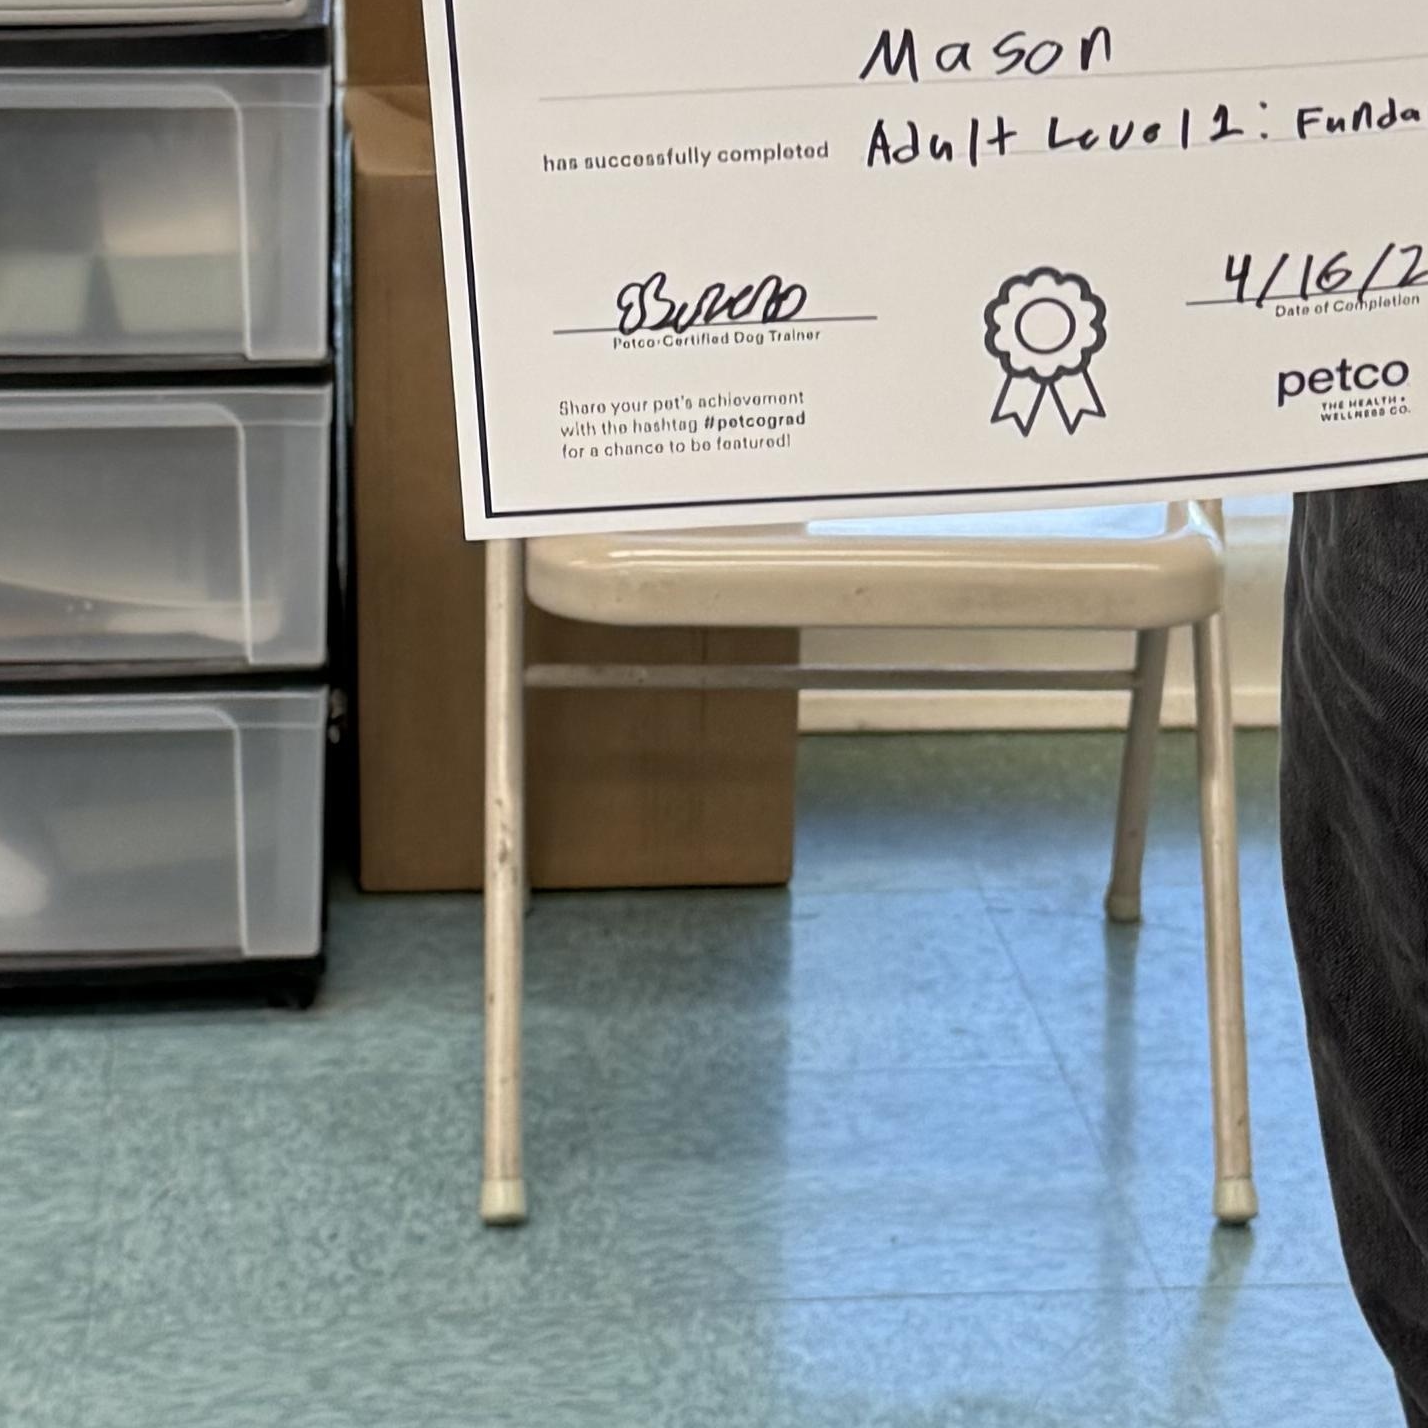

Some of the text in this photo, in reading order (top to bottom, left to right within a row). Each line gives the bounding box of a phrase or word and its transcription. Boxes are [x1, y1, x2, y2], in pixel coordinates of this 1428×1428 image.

[858, 26, 1112, 83] Mason
[866, 115, 1018, 168] Adult
[1047, 107, 1191, 150] Level
[542, 141, 829, 172] has successfully completed
[1275, 293, 1421, 318] Date of Completion
[734, 330, 765, 346] Dog
[768, 329, 821, 343] Trainer
[1278, 358, 1410, 408] petco
[559, 391, 805, 417] Share your pet's achievement
[1320, 404, 1412, 422] WELLNESS CO.
[1322, 400, 1345, 411] THE
[1349, 395, 1397, 409] HEALTH
[560, 410, 807, 437] with the hashtag #petcograd
[562, 433, 791, 459] for a chance to be featured!
